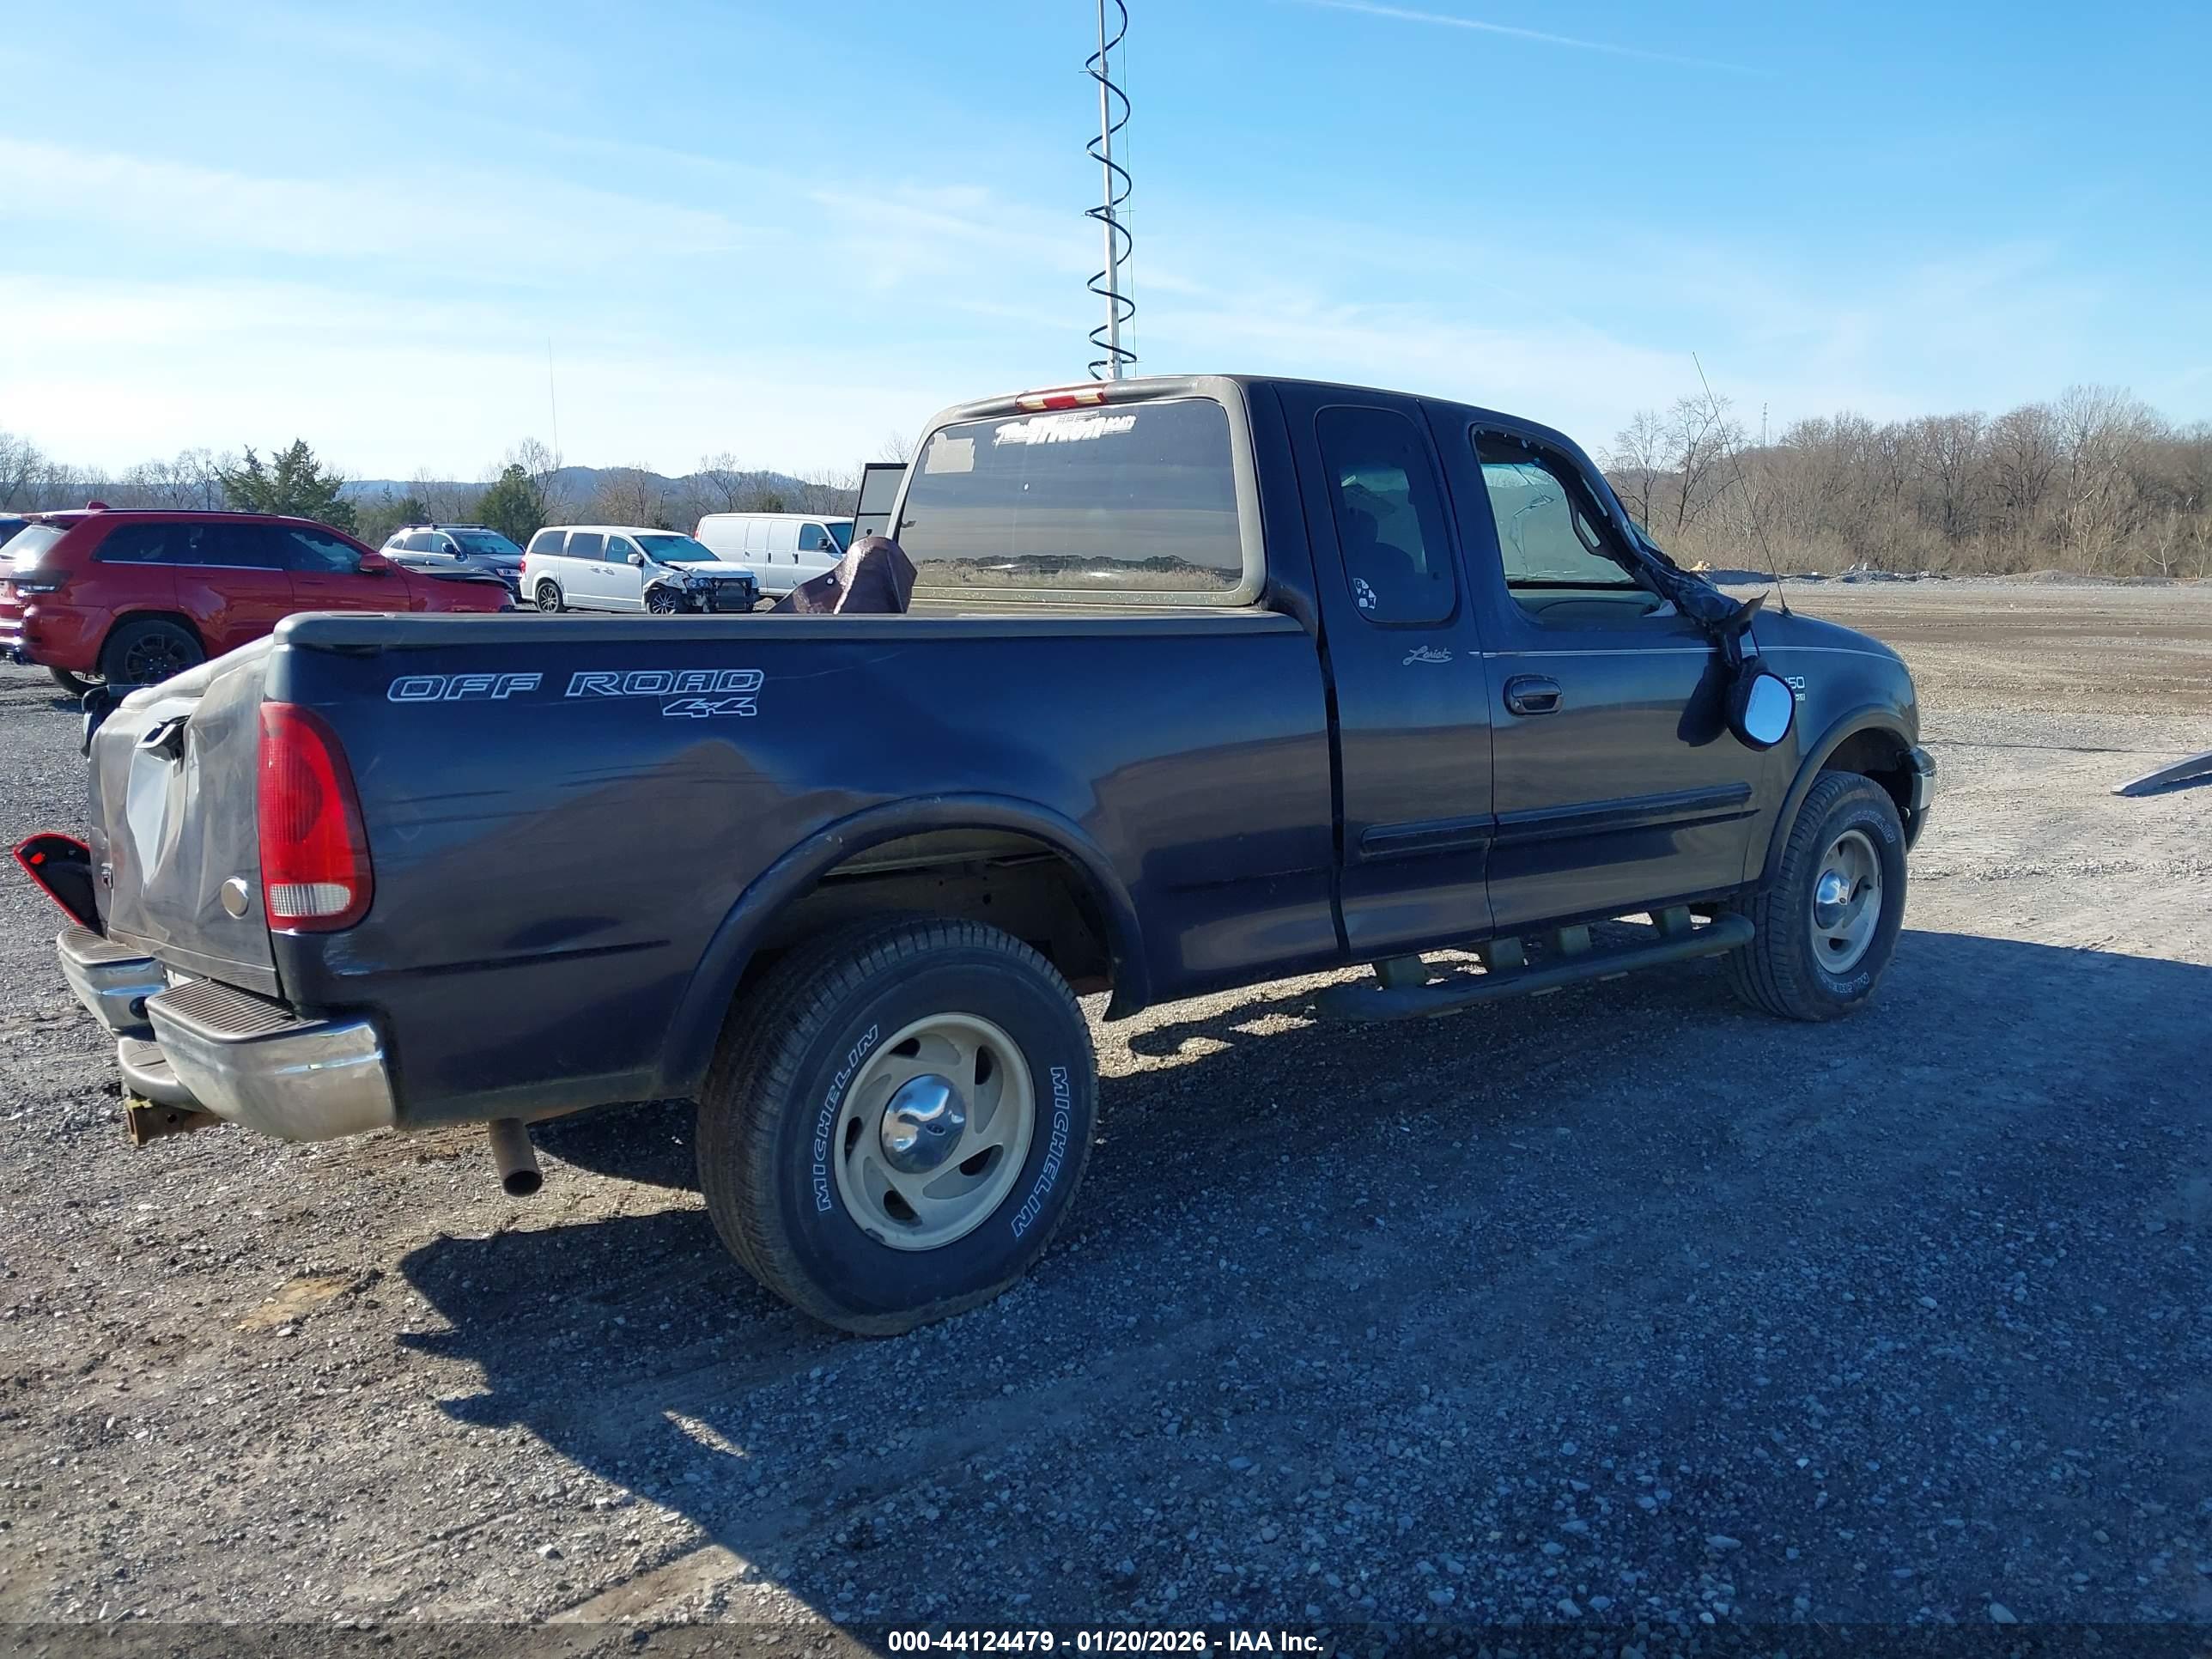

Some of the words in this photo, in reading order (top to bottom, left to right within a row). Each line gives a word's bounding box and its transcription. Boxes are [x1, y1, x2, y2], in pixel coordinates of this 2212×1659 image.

[386, 672, 543, 701] OFF
[564, 669, 763, 696] ROAD
[813, 1024, 878, 1213] MICHELIN
[1012, 1066, 1070, 1238] MICHELIN
